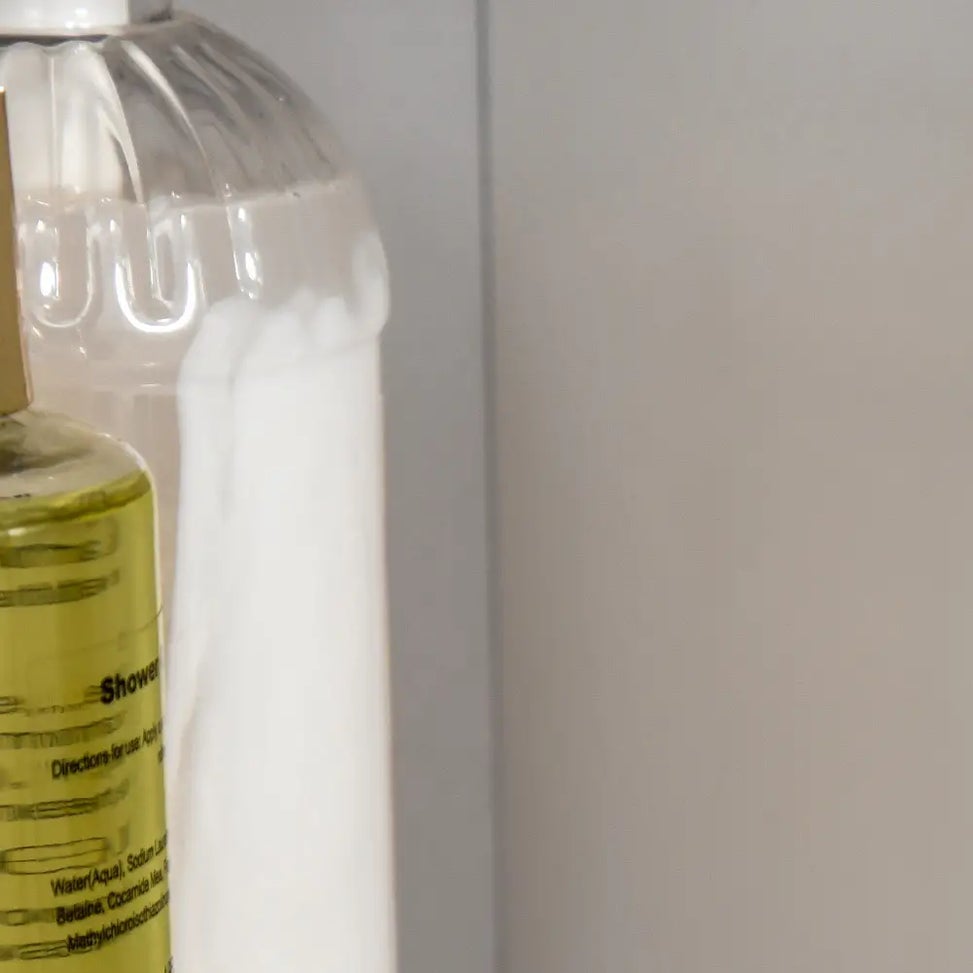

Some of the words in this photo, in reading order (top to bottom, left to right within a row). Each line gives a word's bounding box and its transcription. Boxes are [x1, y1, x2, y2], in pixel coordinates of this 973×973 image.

[100, 656, 159, 704] Shower
[51, 749, 108, 780] Directions
[111, 743, 124, 761] for
[127, 845, 154, 872] Sodium
[107, 877, 149, 910] Cocamide
